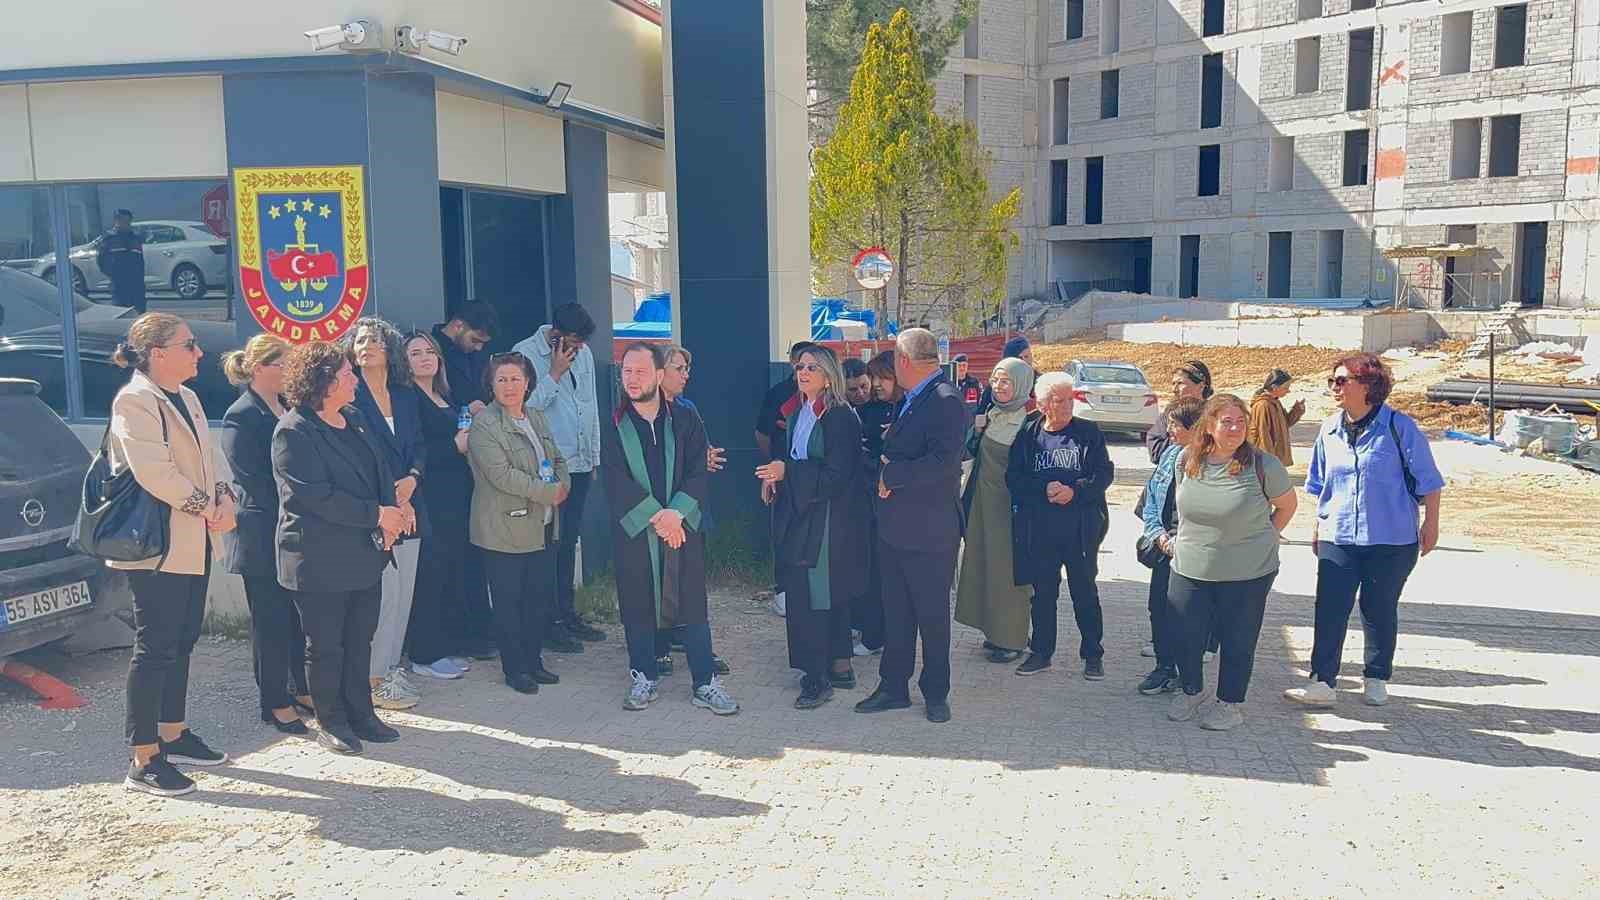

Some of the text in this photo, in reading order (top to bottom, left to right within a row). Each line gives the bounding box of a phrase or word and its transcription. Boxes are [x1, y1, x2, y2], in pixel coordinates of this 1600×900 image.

[248, 287, 362, 341] JANDARMA
[295, 300, 314, 308] 1839
[6, 583, 89, 621] 55 ASV 364
